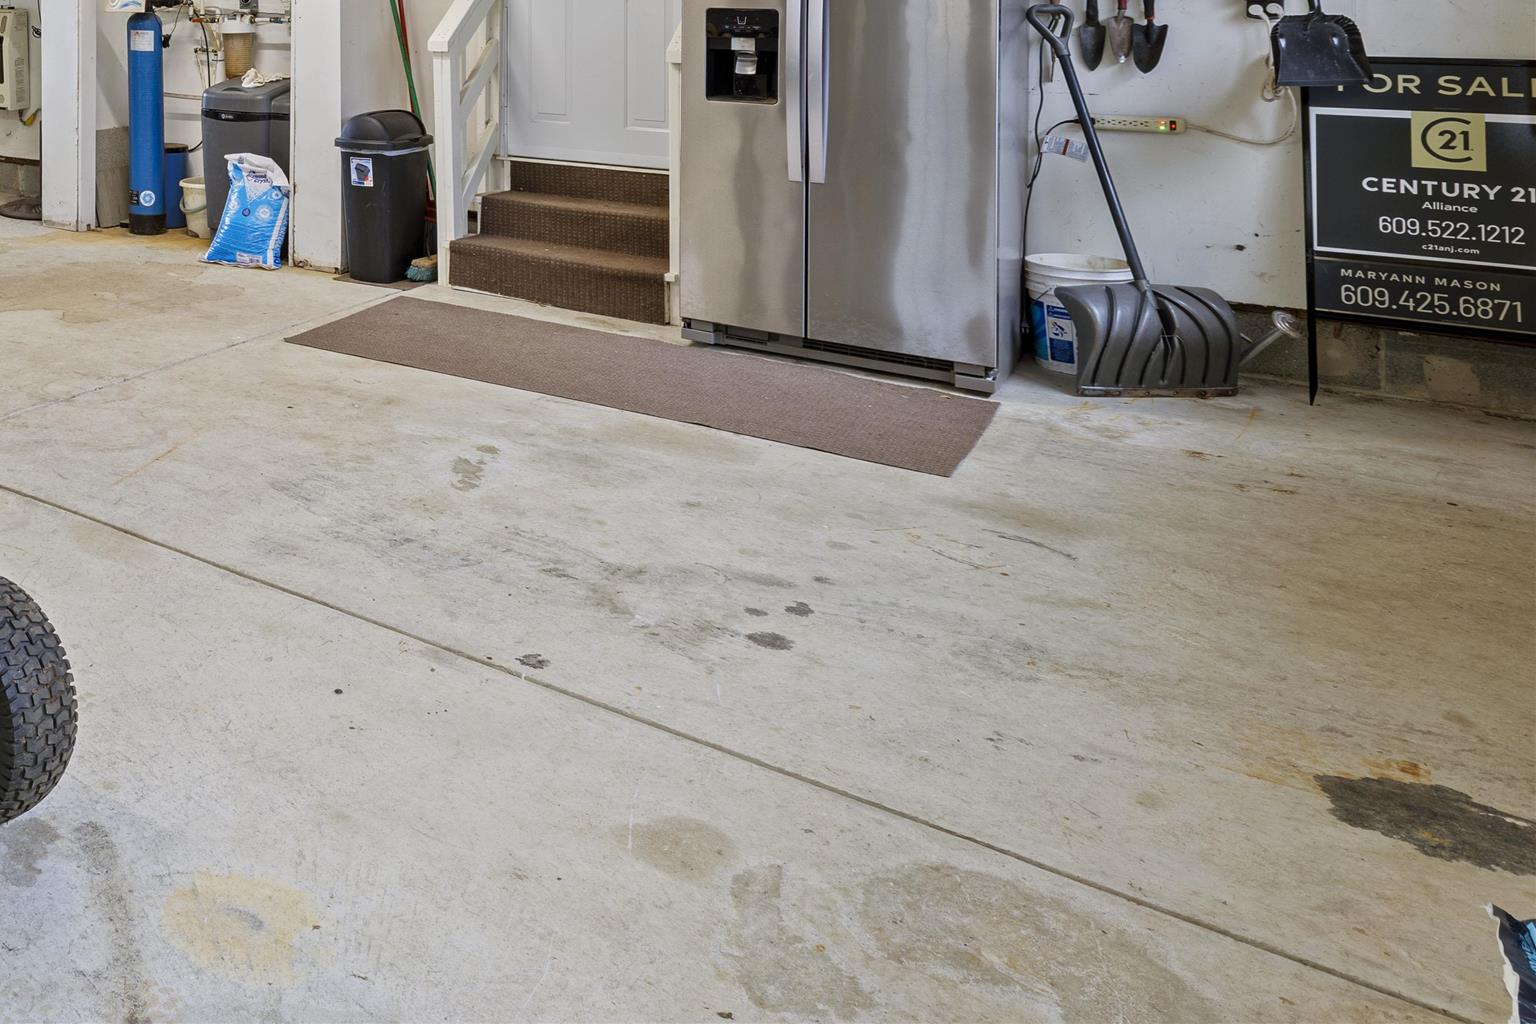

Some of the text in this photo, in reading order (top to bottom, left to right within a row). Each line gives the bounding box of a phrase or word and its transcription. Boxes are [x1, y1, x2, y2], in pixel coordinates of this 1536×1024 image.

[1337, 74, 1421, 94] OR
[1361, 177, 1536, 204] CENTURY 21
[1421, 201, 1479, 214] Alliance
[1378, 215, 1527, 246] 609.522.1212
[1421, 242, 1481, 256] c21anj.com
[1340, 268, 1501, 292] MARYANN MASON
[1340, 284, 1523, 323] 609.425.6871
